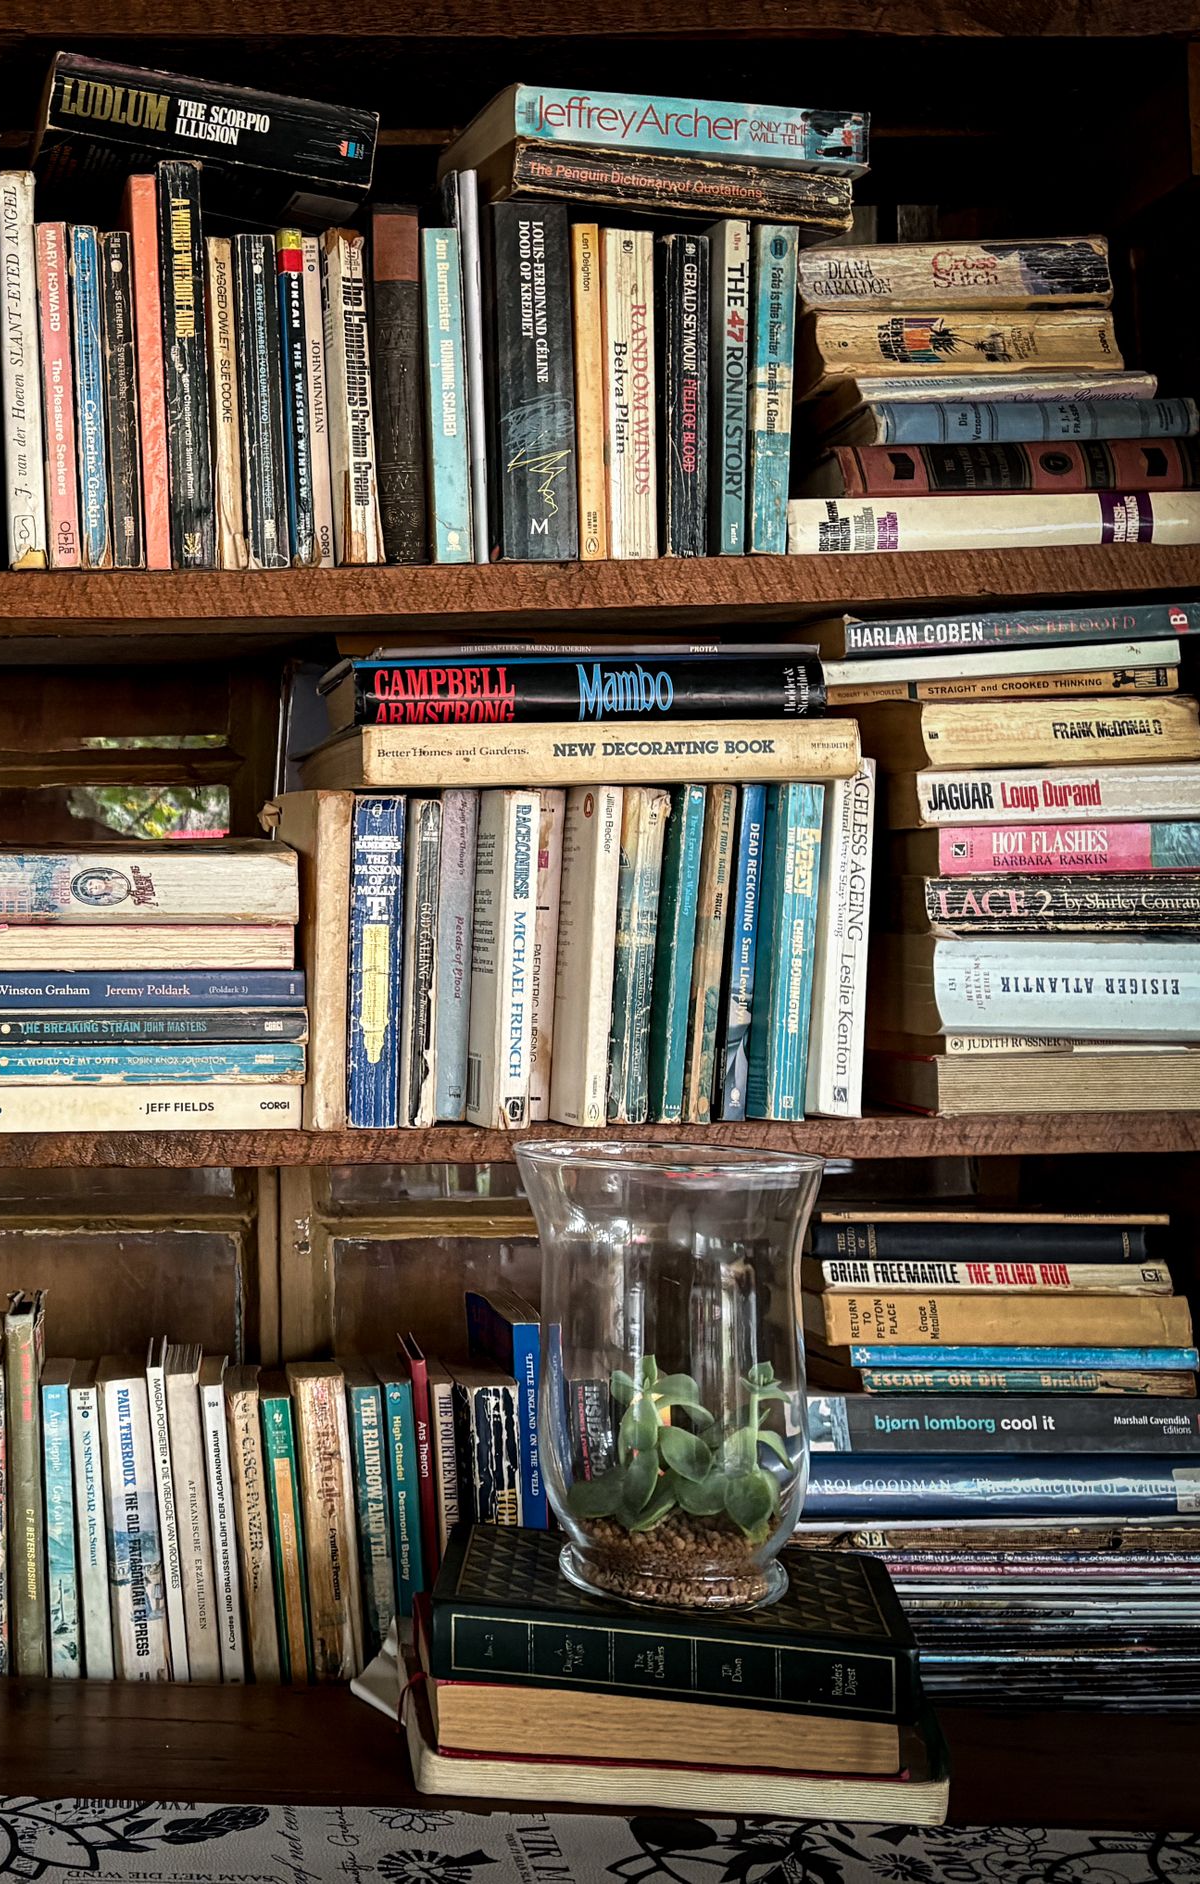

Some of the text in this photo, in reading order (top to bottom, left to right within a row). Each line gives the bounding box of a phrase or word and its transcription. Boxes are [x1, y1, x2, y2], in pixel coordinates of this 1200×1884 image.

[60, 78, 170, 131] LUDLUM
[178, 99, 270, 133] THE SCORPIO
[535, 95, 747, 142] Jeffrey Archer
[175, 118, 239, 145] ILLUSION
[749, 132, 805, 145] WILL TELL
[750, 121, 808, 134] ONLY TIME
[47, 230, 61, 332] MARY HOWARD
[828, 260, 875, 280] DIANA
[813, 278, 893, 295] GABALDON
[724, 263, 744, 501] THE 47 RONIN STORY
[320, 525, 328, 558] CORGI
[850, 621, 983, 648] HARLAN COBEN
[374, 663, 674, 720] CAMPBELL Mambo
[928, 678, 1102, 694] STRAIGHT and CROOKED THINKING
[375, 701, 515, 723] ARMSTRONG
[377, 748, 411, 758] Better
[413, 747, 452, 757] Homes
[456, 747, 476, 756] and
[553, 743, 596, 757] NEW
[602, 740, 719, 756] DECORATING
[724, 740, 775, 754] BOOK
[928, 779, 1102, 811] JAGUAR Loup Durand
[992, 830, 1108, 854] HOT FLASHES
[355, 865, 400, 875] PASSION
[366, 854, 389, 864] THE
[993, 854, 1108, 866] BARBARA RASKIN
[357, 885, 398, 895] MOLLY
[369, 875, 386, 885] OF
[45, 985, 90, 995] Graham
[106, 985, 144, 996] Jeremy
[147, 985, 190, 995] Poldark
[509, 911, 527, 1078] MICHAEL FRENCH
[1001, 977, 1180, 994] EISIGER ATLANTIK
[835, 952, 855, 1076] Leslie Kenton
[146, 1102, 214, 1113] JEFF FIELDS
[260, 1102, 289, 1110] CORGI
[829, 1262, 1071, 1286] BRIAN FREEMANTLE THE BLIND RUN
[851, 1299, 860, 1338] RETURN
[863, 1312, 871, 1324] TO
[876, 1299, 885, 1338] PEYTON
[890, 1303, 898, 1335] PLACE
[874, 1414, 1055, 1432] bjørn lomborg cool it
[1114, 1416, 1190, 1426] Marshall Cavendish
[1163, 1425, 1191, 1434] Editions
[117, 1389, 136, 1486] PAUL THEROUX
[393, 1416, 408, 1543] High Citadel Desmond
